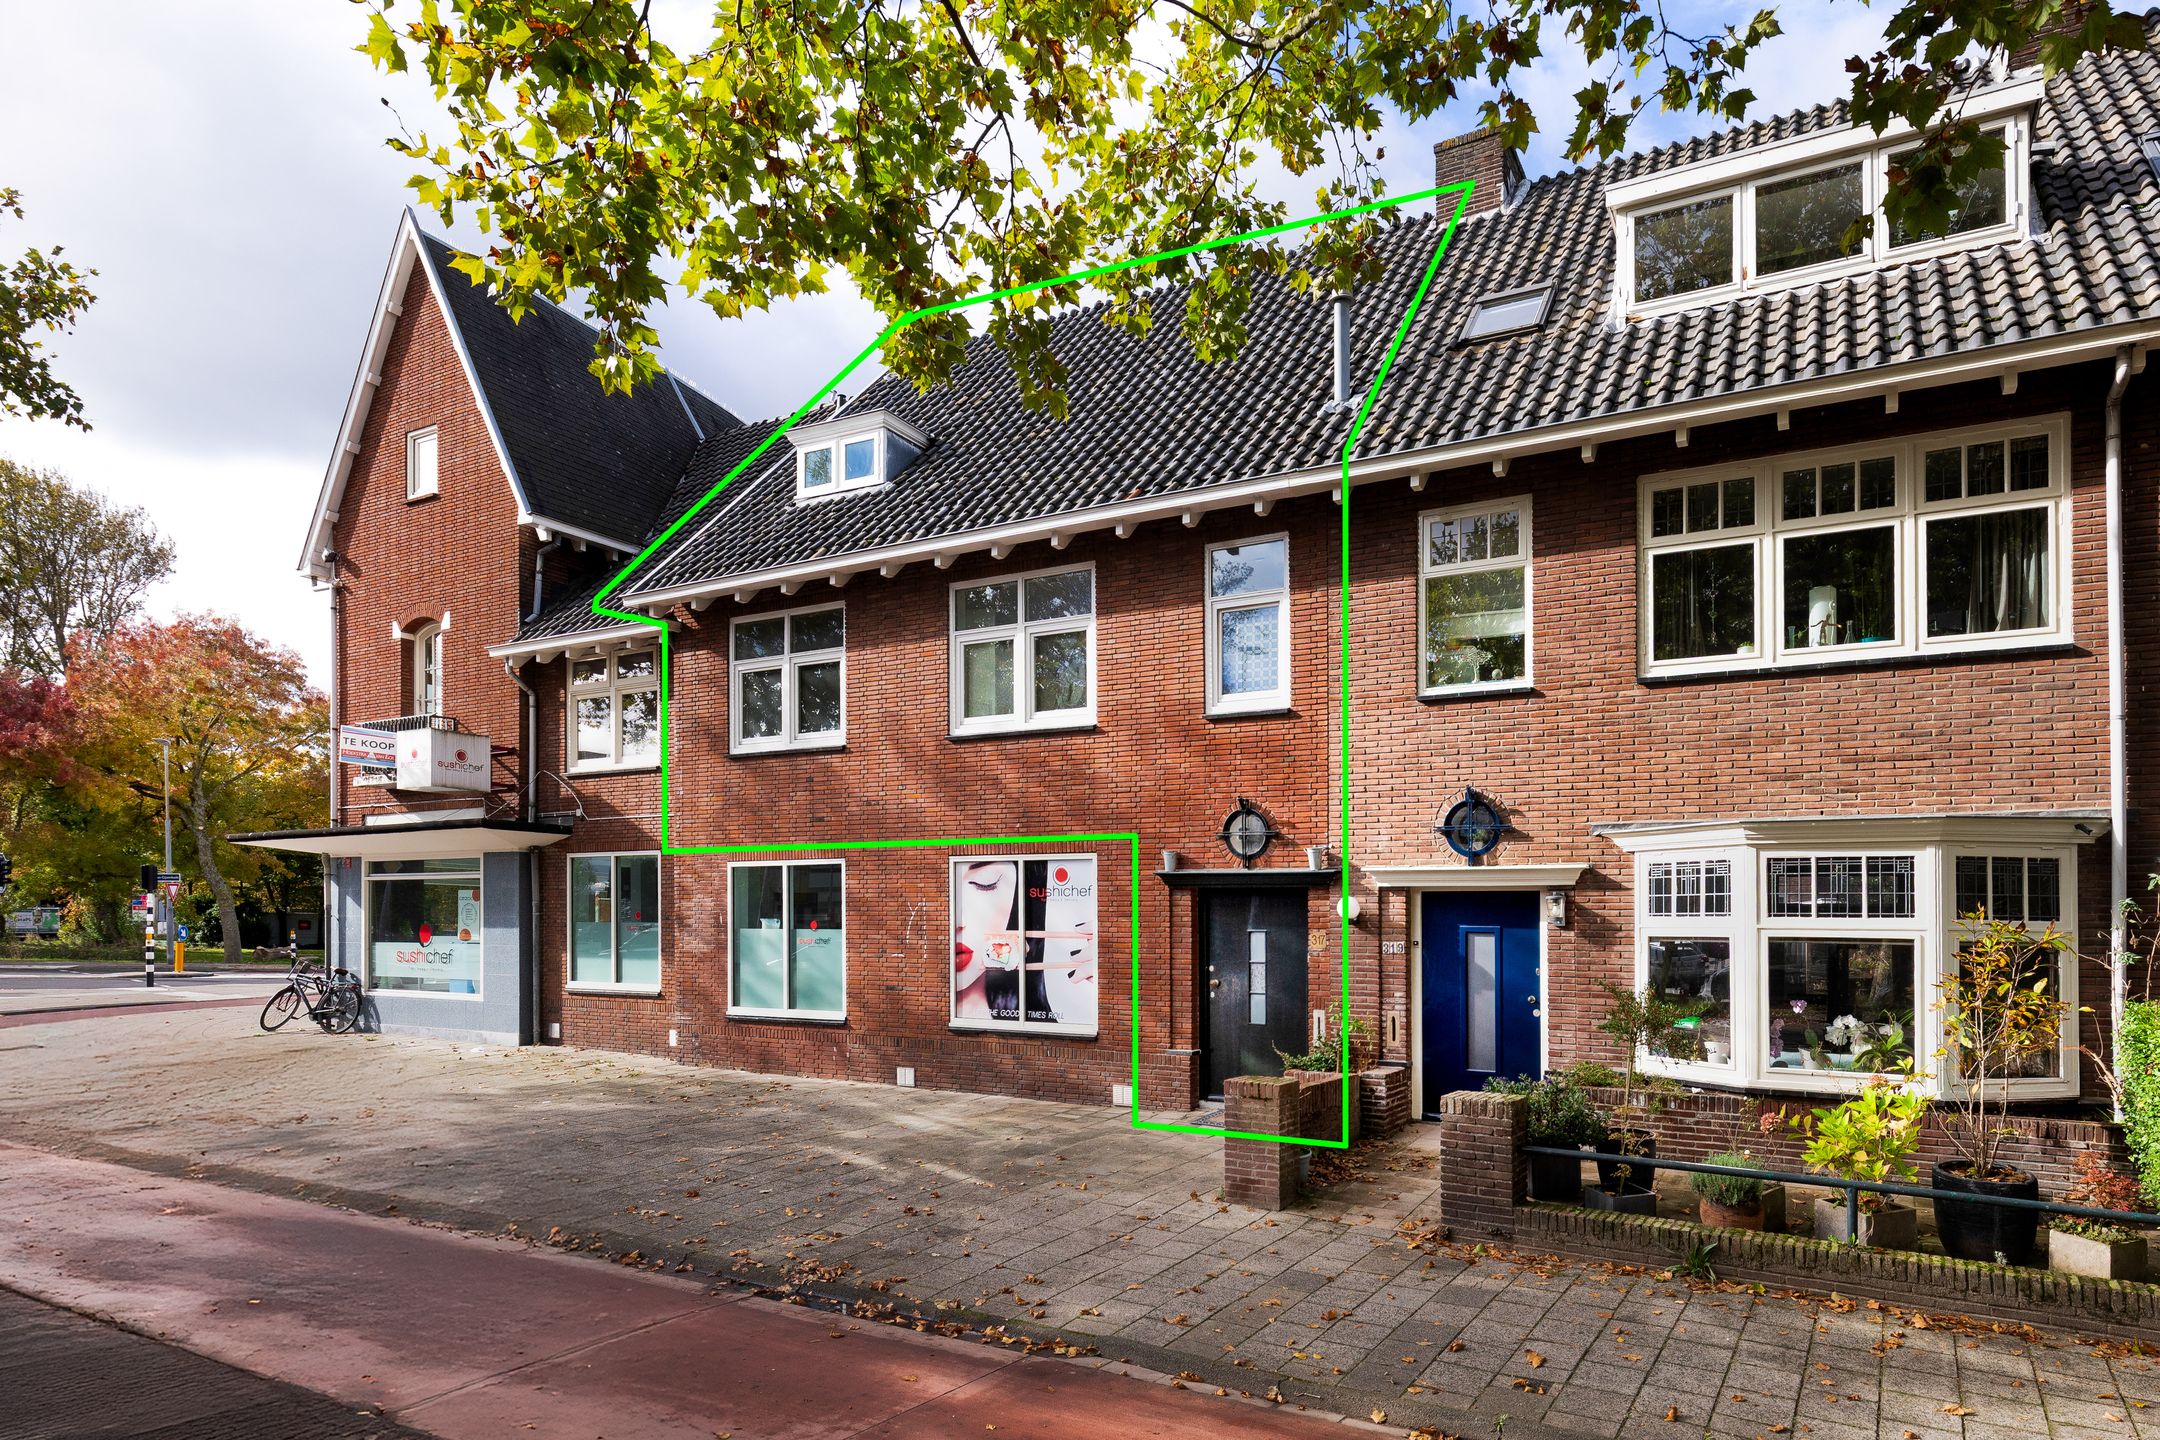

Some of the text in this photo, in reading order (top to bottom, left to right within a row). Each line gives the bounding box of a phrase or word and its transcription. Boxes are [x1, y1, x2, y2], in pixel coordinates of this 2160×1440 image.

[343, 737, 395, 750] TE KOOP
[437, 760, 485, 772] sushichef
[1029, 885, 1094, 898] sushichef
[1311, 934, 1326, 946] 317
[1383, 942, 1405, 954] 319
[396, 948, 454, 964] sushichef
[1000, 1009, 1021, 1018] GOOD
[1027, 1010, 1047, 1019] TIMES
